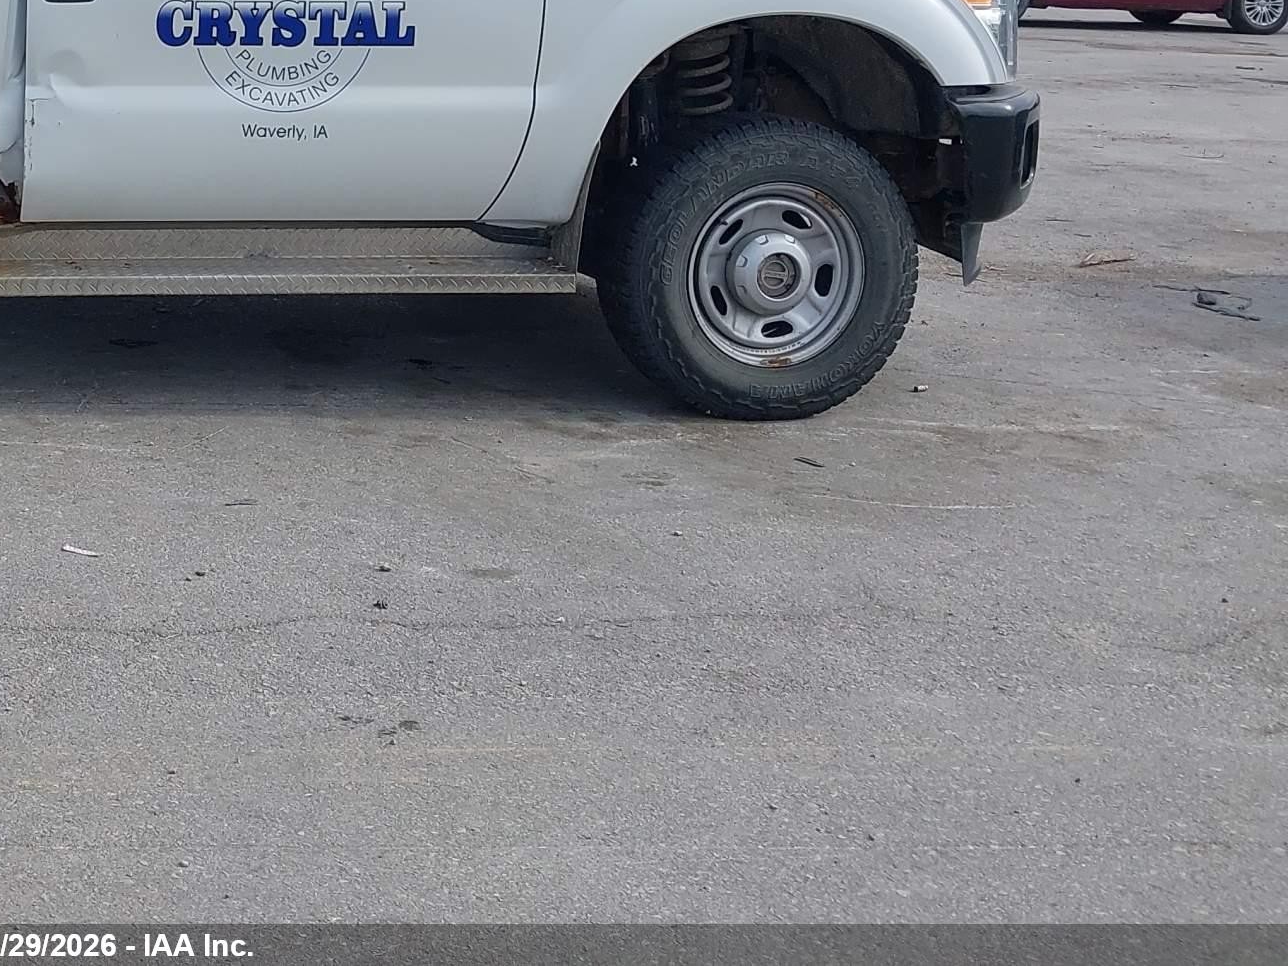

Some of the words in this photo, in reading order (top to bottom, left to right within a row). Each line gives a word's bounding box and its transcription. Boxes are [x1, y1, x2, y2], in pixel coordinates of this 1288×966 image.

[156, 0, 416, 47] CRYSTAL
[235, 49, 332, 81] PLUMBING
[225, 71, 339, 107] EXCAVATING
[242, 124, 307, 141] Waverly,
[313, 124, 328, 139] IA
